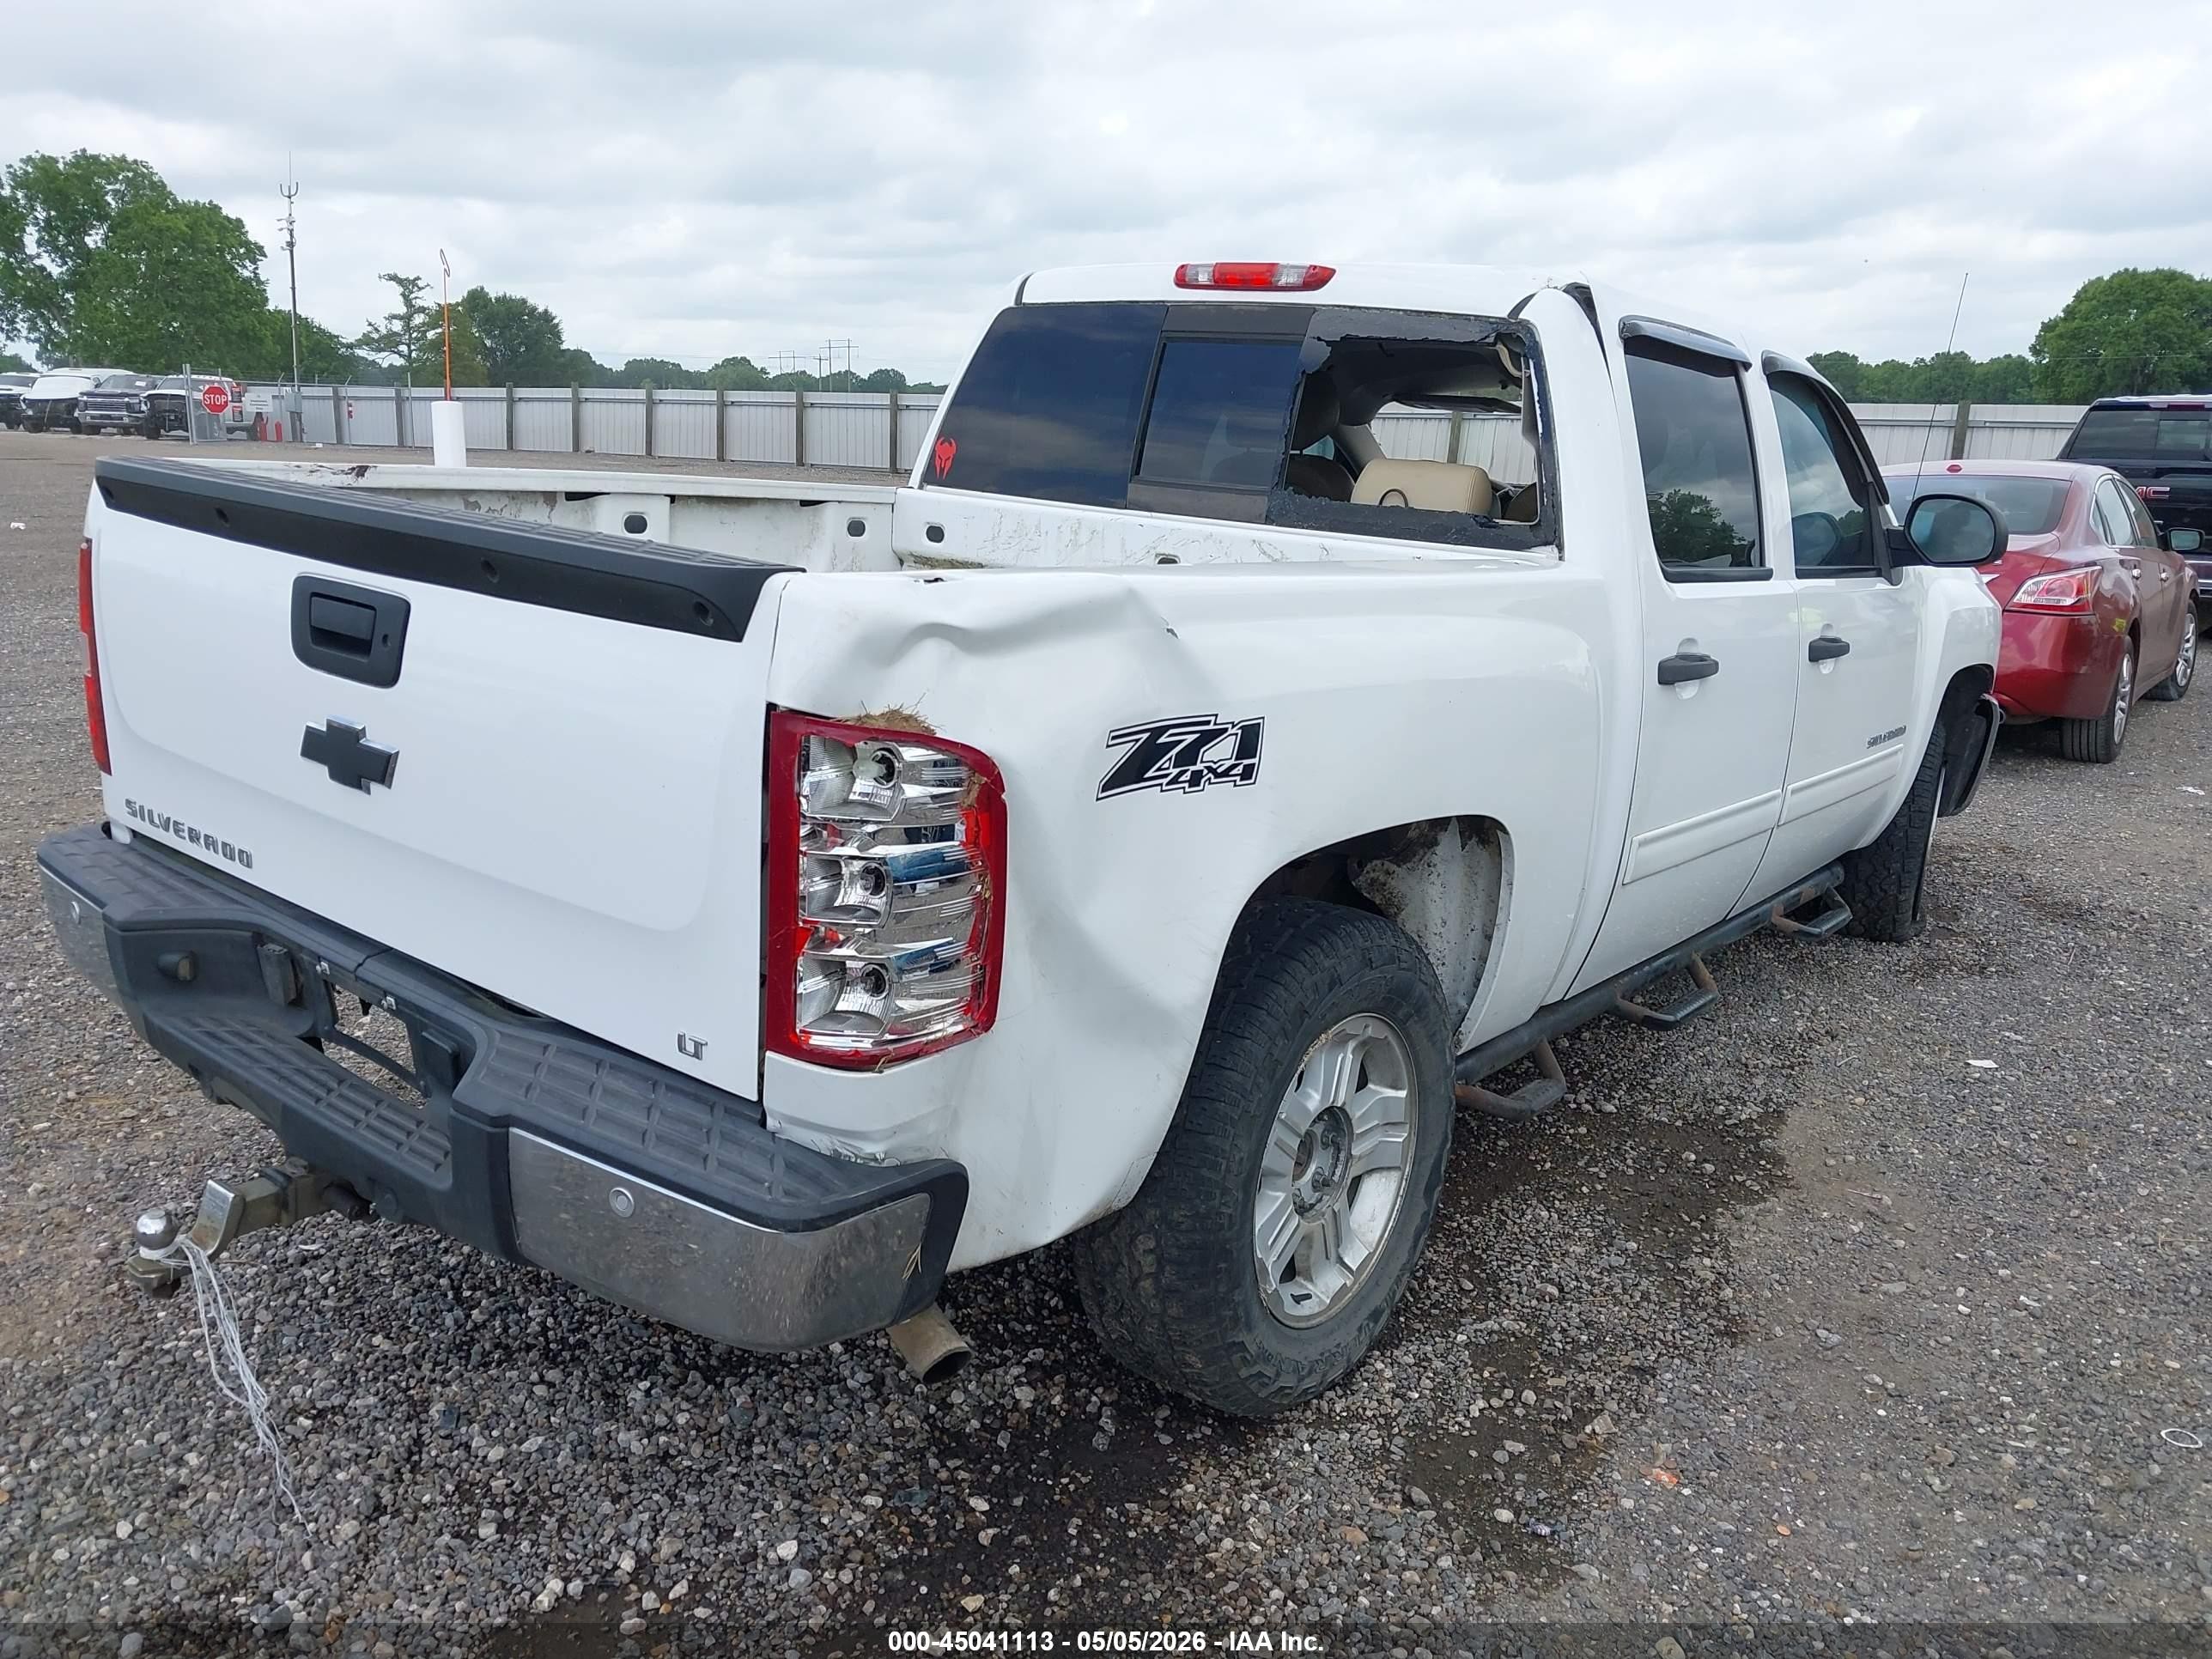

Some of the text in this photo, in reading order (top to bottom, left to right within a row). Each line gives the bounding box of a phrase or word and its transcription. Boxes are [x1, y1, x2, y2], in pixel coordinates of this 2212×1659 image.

[204, 394, 228, 405] STOP
[1095, 713, 1266, 802] Z71
[125, 798, 253, 870] SILVERADO
[677, 1031, 708, 1061] LT
